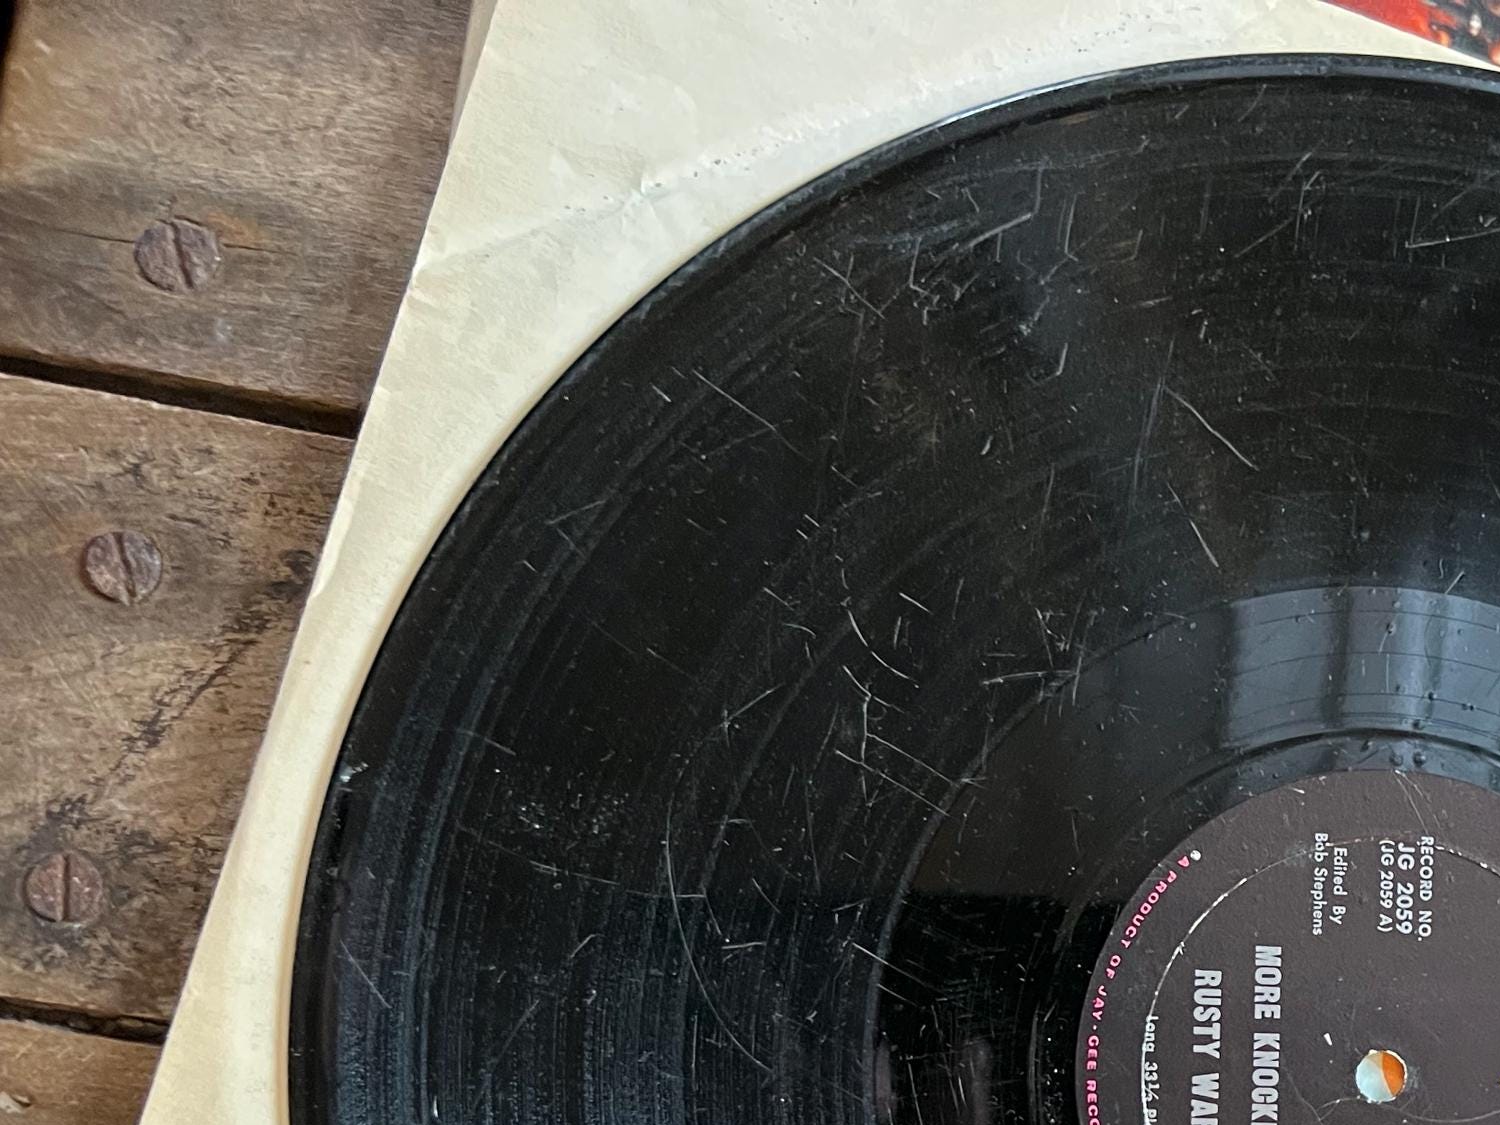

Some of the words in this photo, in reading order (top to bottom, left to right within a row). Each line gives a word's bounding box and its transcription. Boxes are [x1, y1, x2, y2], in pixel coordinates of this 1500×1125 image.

[1178, 856, 1189, 867] A
[1314, 833, 1328, 862] Bob
[1379, 840, 1395, 866] (JG
[1398, 842, 1415, 870] JG
[1334, 848, 1348, 895] Edited
[1420, 836, 1434, 901] RECORD
[1310, 867, 1328, 936] Stephens
[1380, 870, 1393, 908] 2059
[1121, 870, 1177, 948] PRODUCT
[1329, 906, 1346, 924] By
[1377, 914, 1392, 932] A)
[1396, 882, 1414, 934] 2059
[1418, 911, 1432, 941] NO.
[1106, 955, 1121, 979] OF
[1254, 946, 1282, 1019] MORE
[1192, 969, 1222, 1059] RUSTY
[1143, 1016, 1159, 1052] Long
